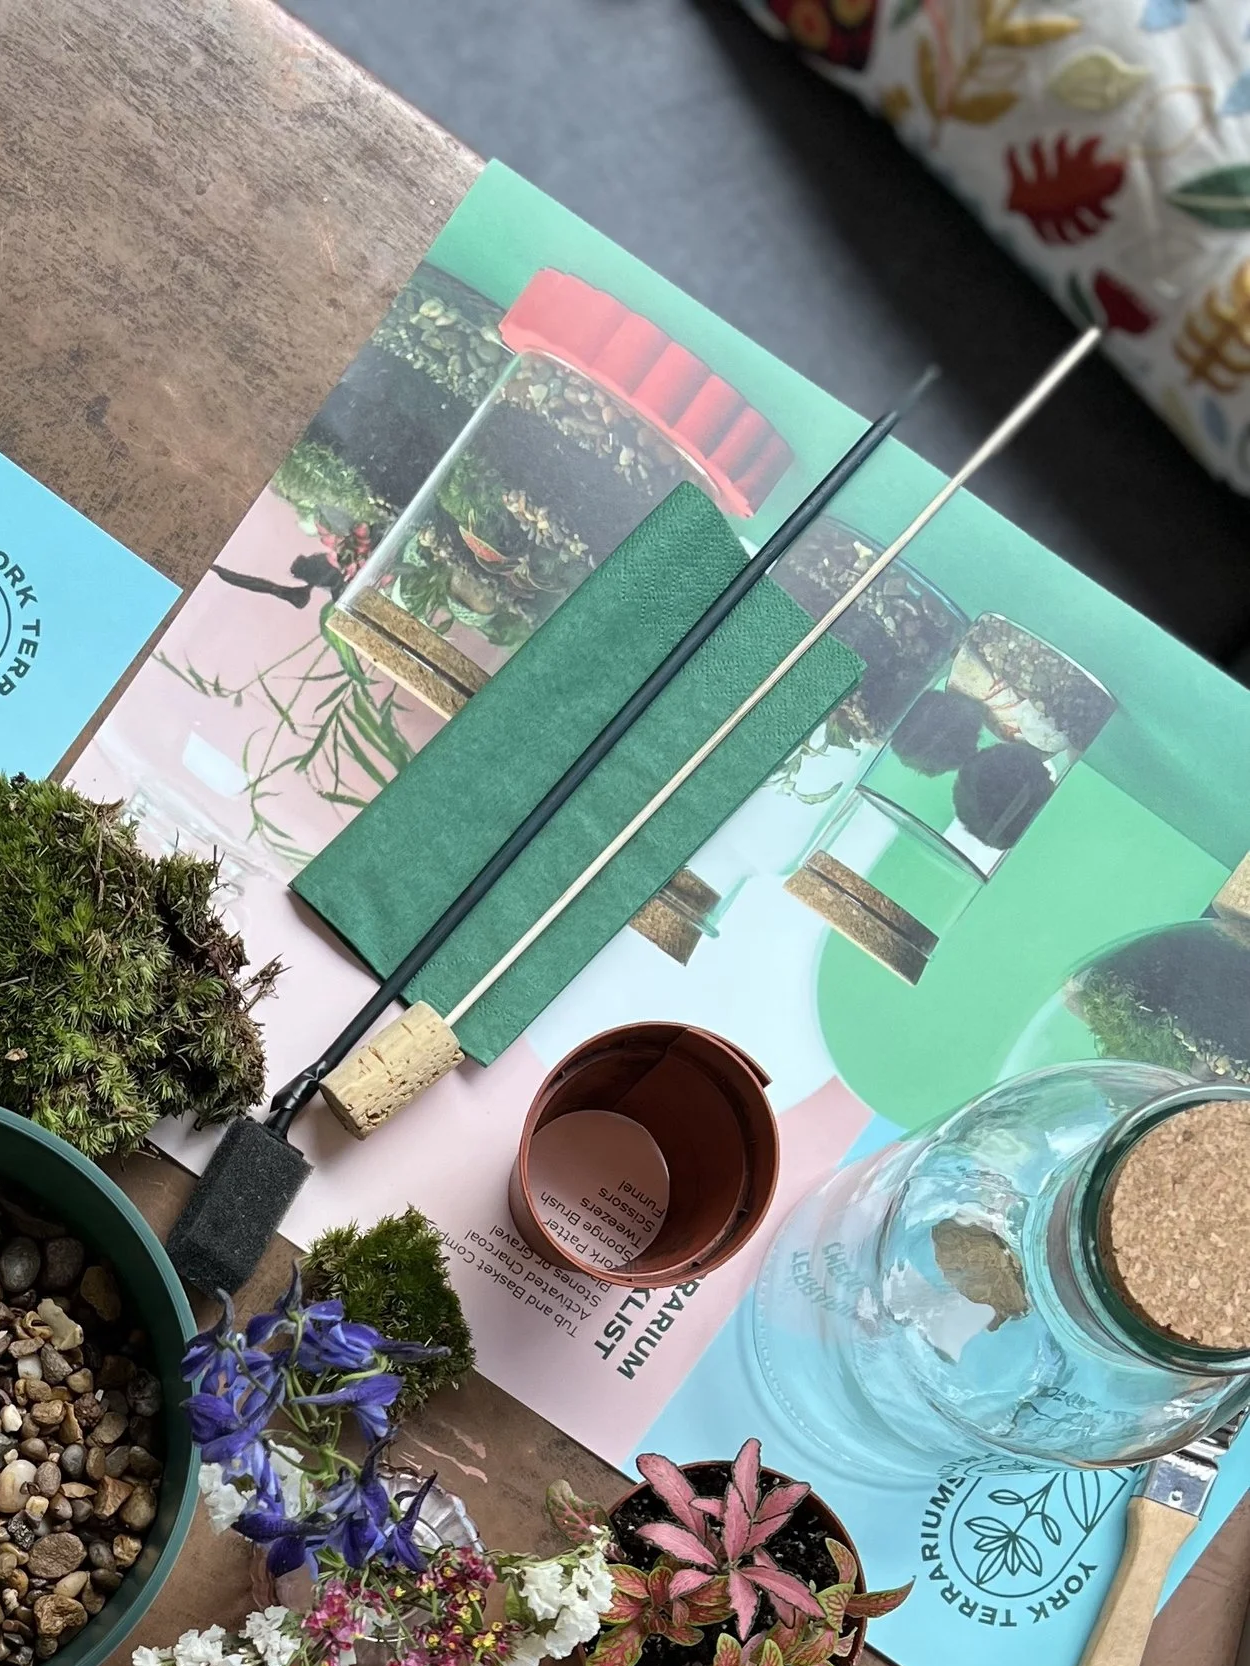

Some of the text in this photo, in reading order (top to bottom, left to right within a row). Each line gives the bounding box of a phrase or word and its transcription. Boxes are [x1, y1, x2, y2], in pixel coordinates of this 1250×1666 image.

[598, 1187, 656, 1233] Scissors
[617, 1180, 666, 1219] Funnel
[489, 1225, 534, 1260] Gravel
[540, 1191, 634, 1262] Sponge Brush
[544, 1218, 616, 1269] ork Patter
[580, 1197, 642, 1249] Tweezers
[464, 1229, 592, 1321] Activated Charcoal
[476, 1259, 526, 1300] Basket
[553, 1268, 602, 1308] Stones
[524, 1294, 553, 1316] and
[554, 1313, 579, 1338] Tub
[616, 1277, 703, 1380] RARIUM
[1026, 1561, 1098, 1625] YORK
